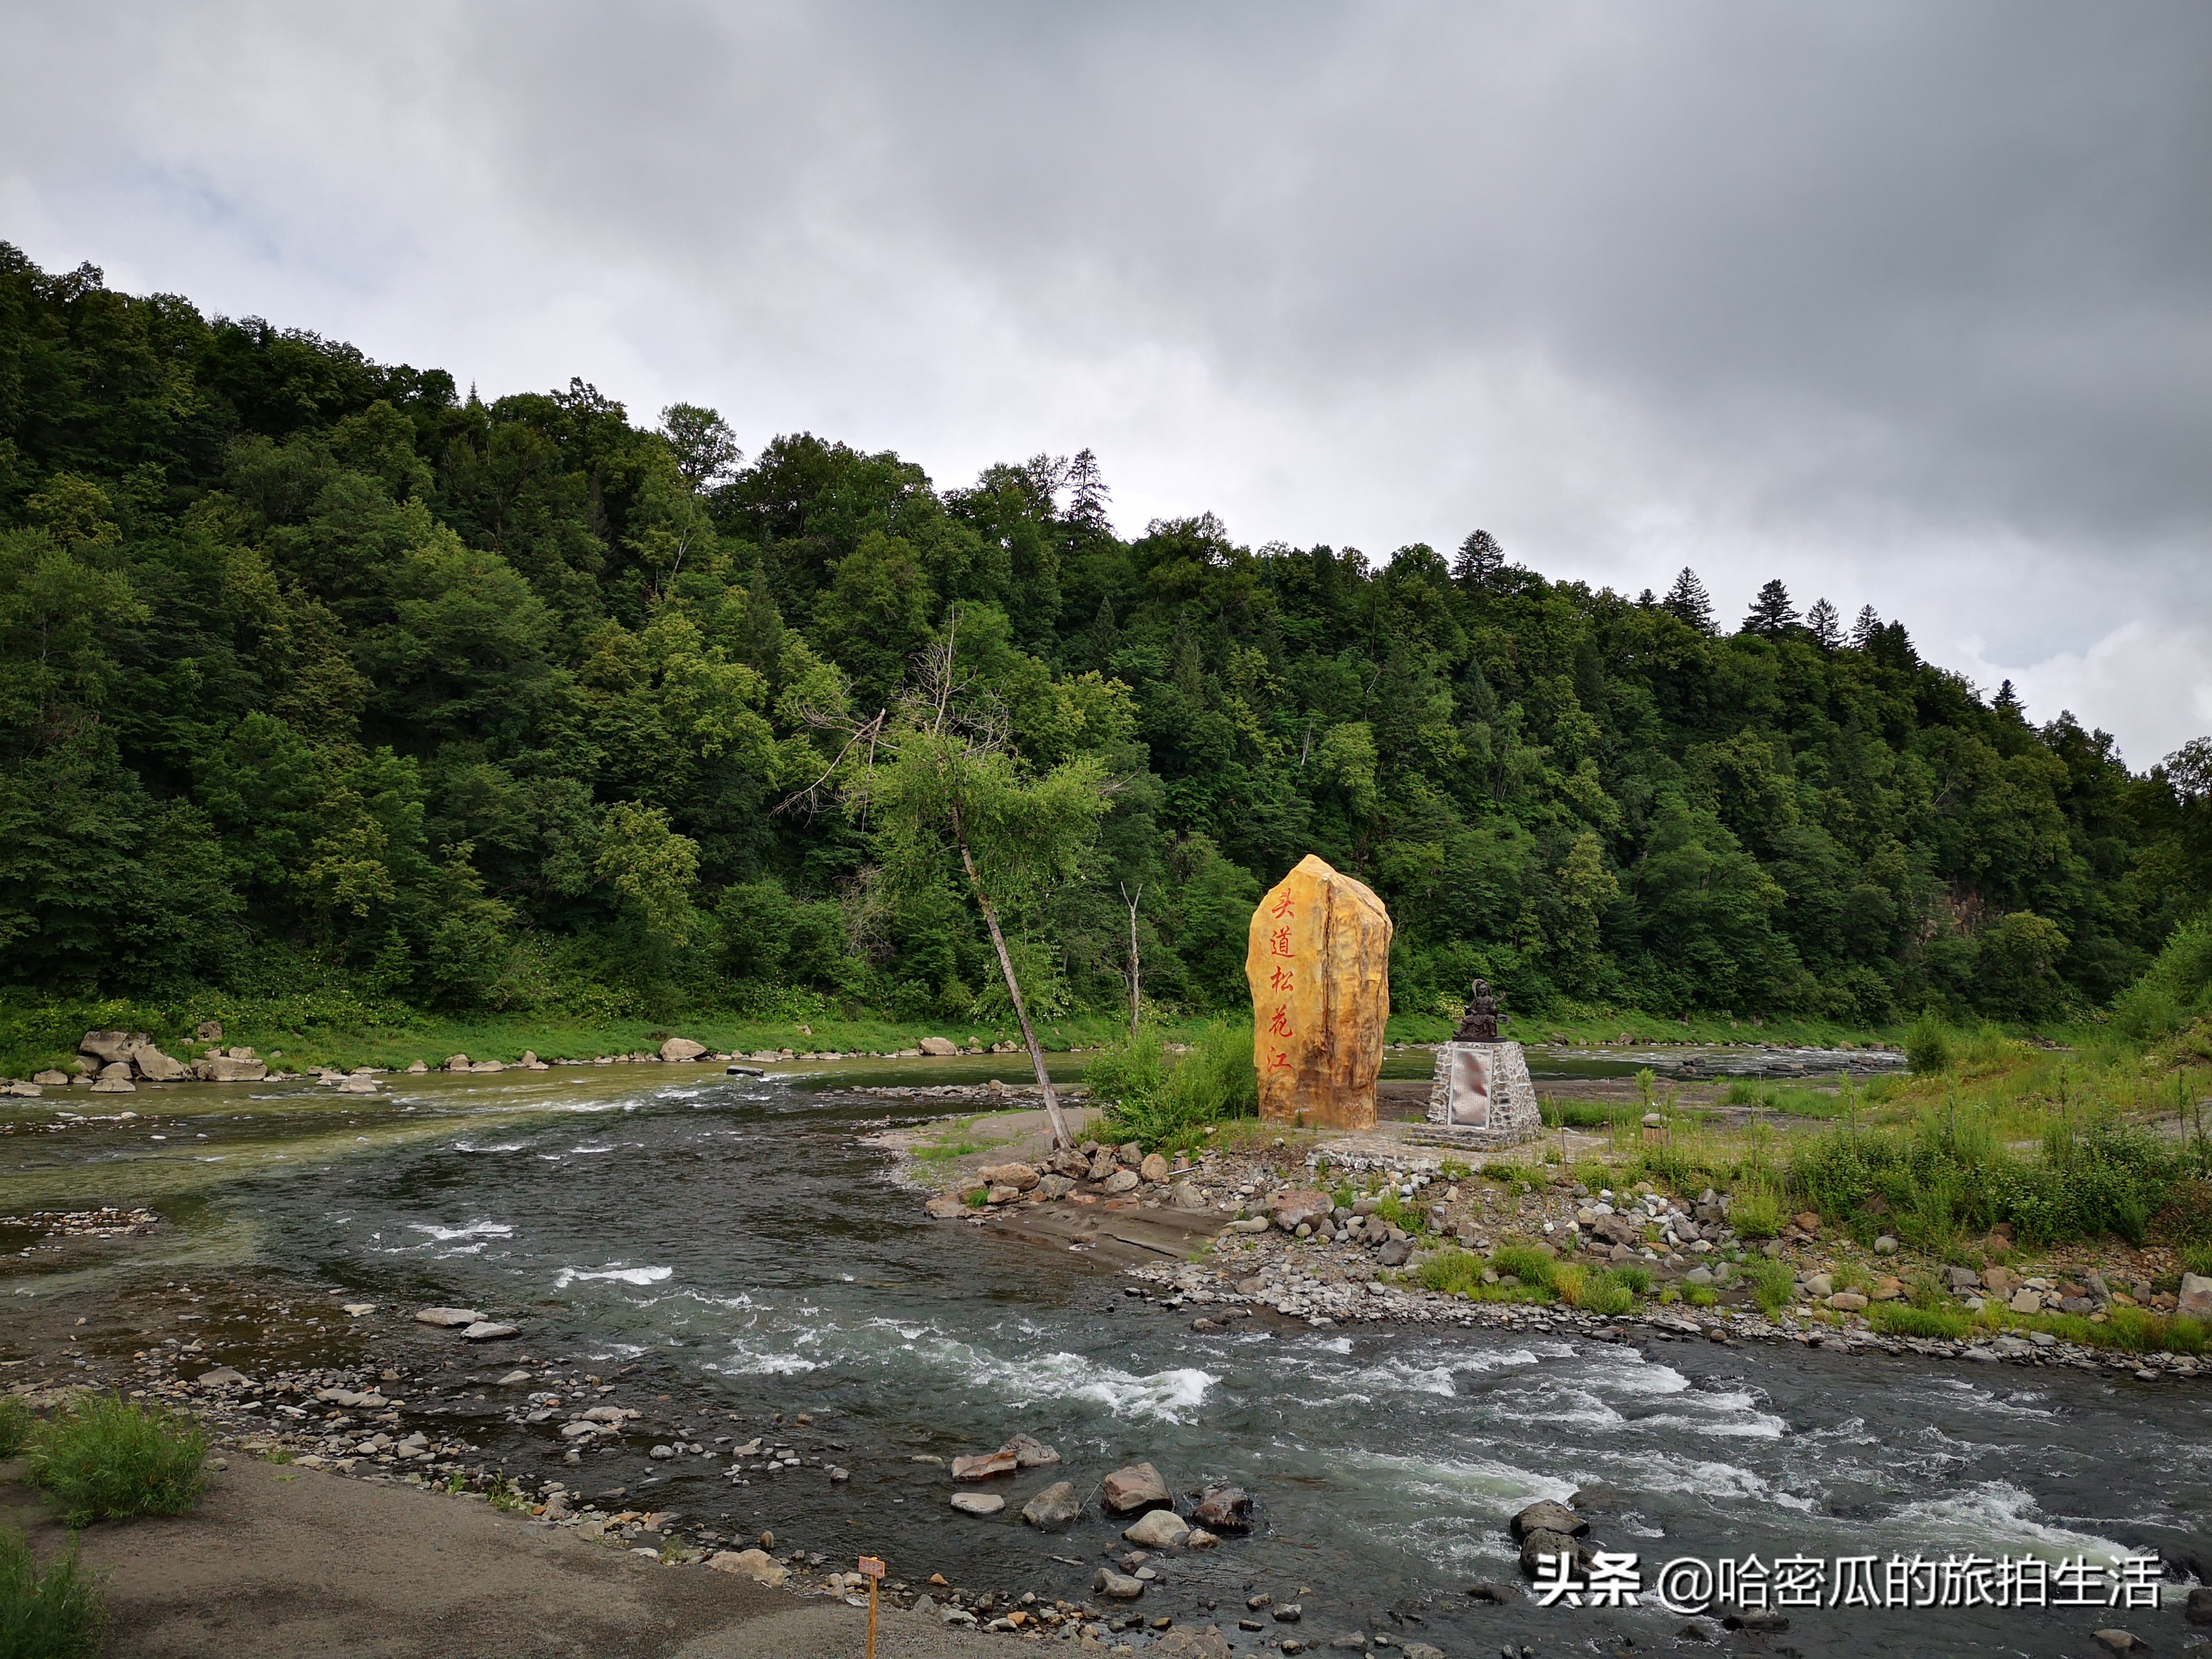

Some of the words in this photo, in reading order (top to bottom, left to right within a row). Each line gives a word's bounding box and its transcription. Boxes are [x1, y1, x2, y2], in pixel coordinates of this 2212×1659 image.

[1266, 887, 1296, 1074] 头道松花江
